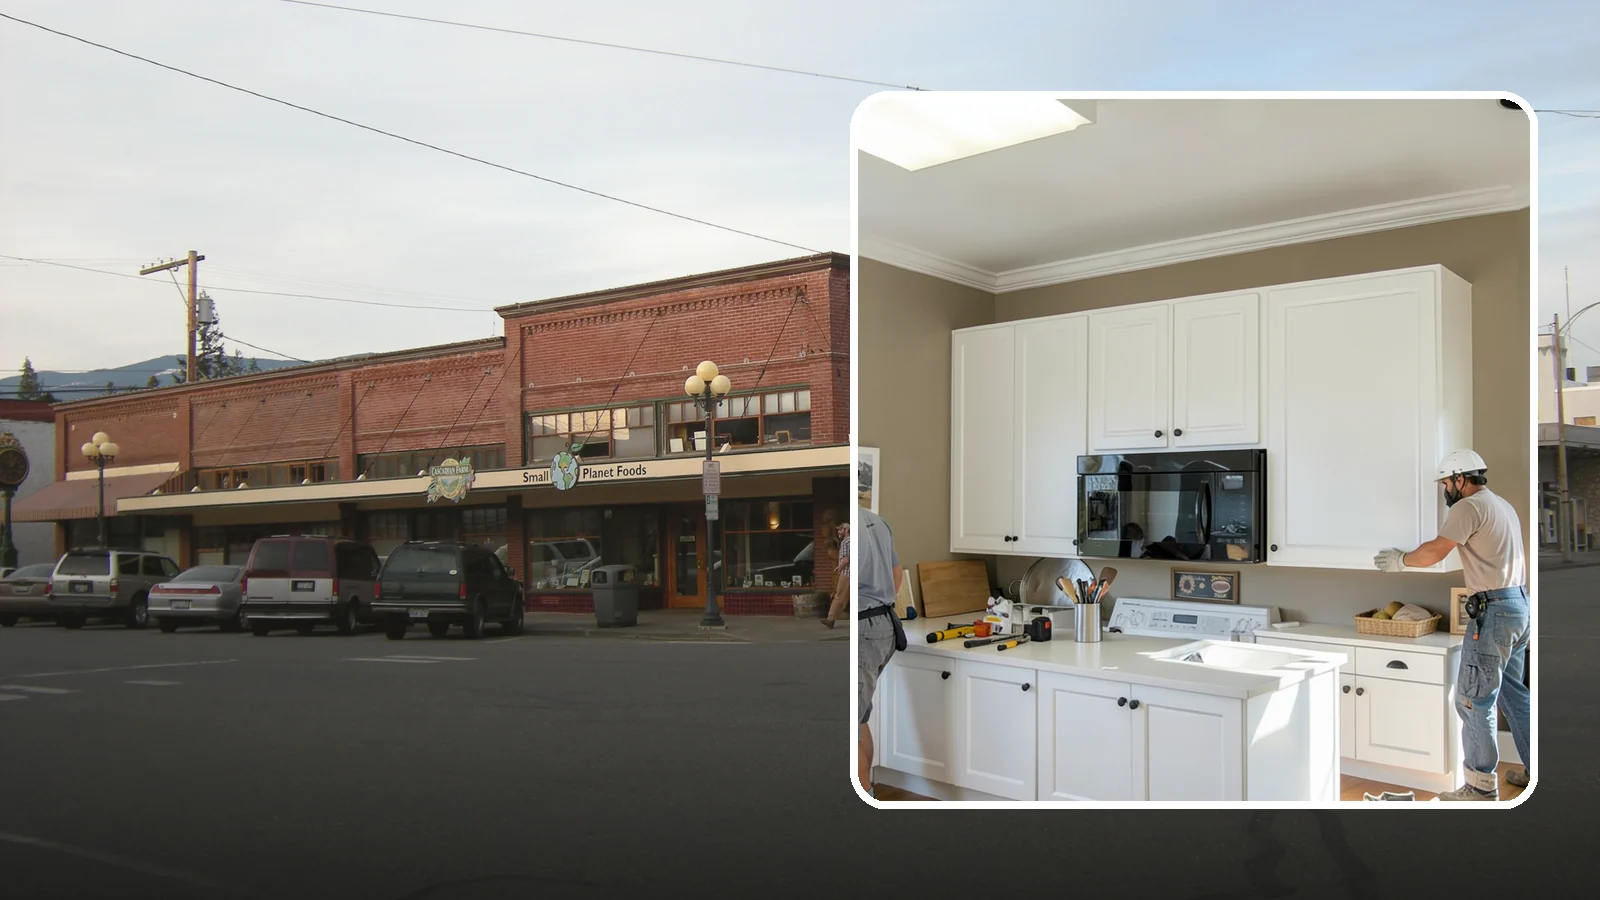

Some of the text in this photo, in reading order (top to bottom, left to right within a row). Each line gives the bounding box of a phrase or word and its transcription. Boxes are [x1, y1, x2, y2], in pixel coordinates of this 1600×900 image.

[523, 464, 647, 483] Small Planet Foods
